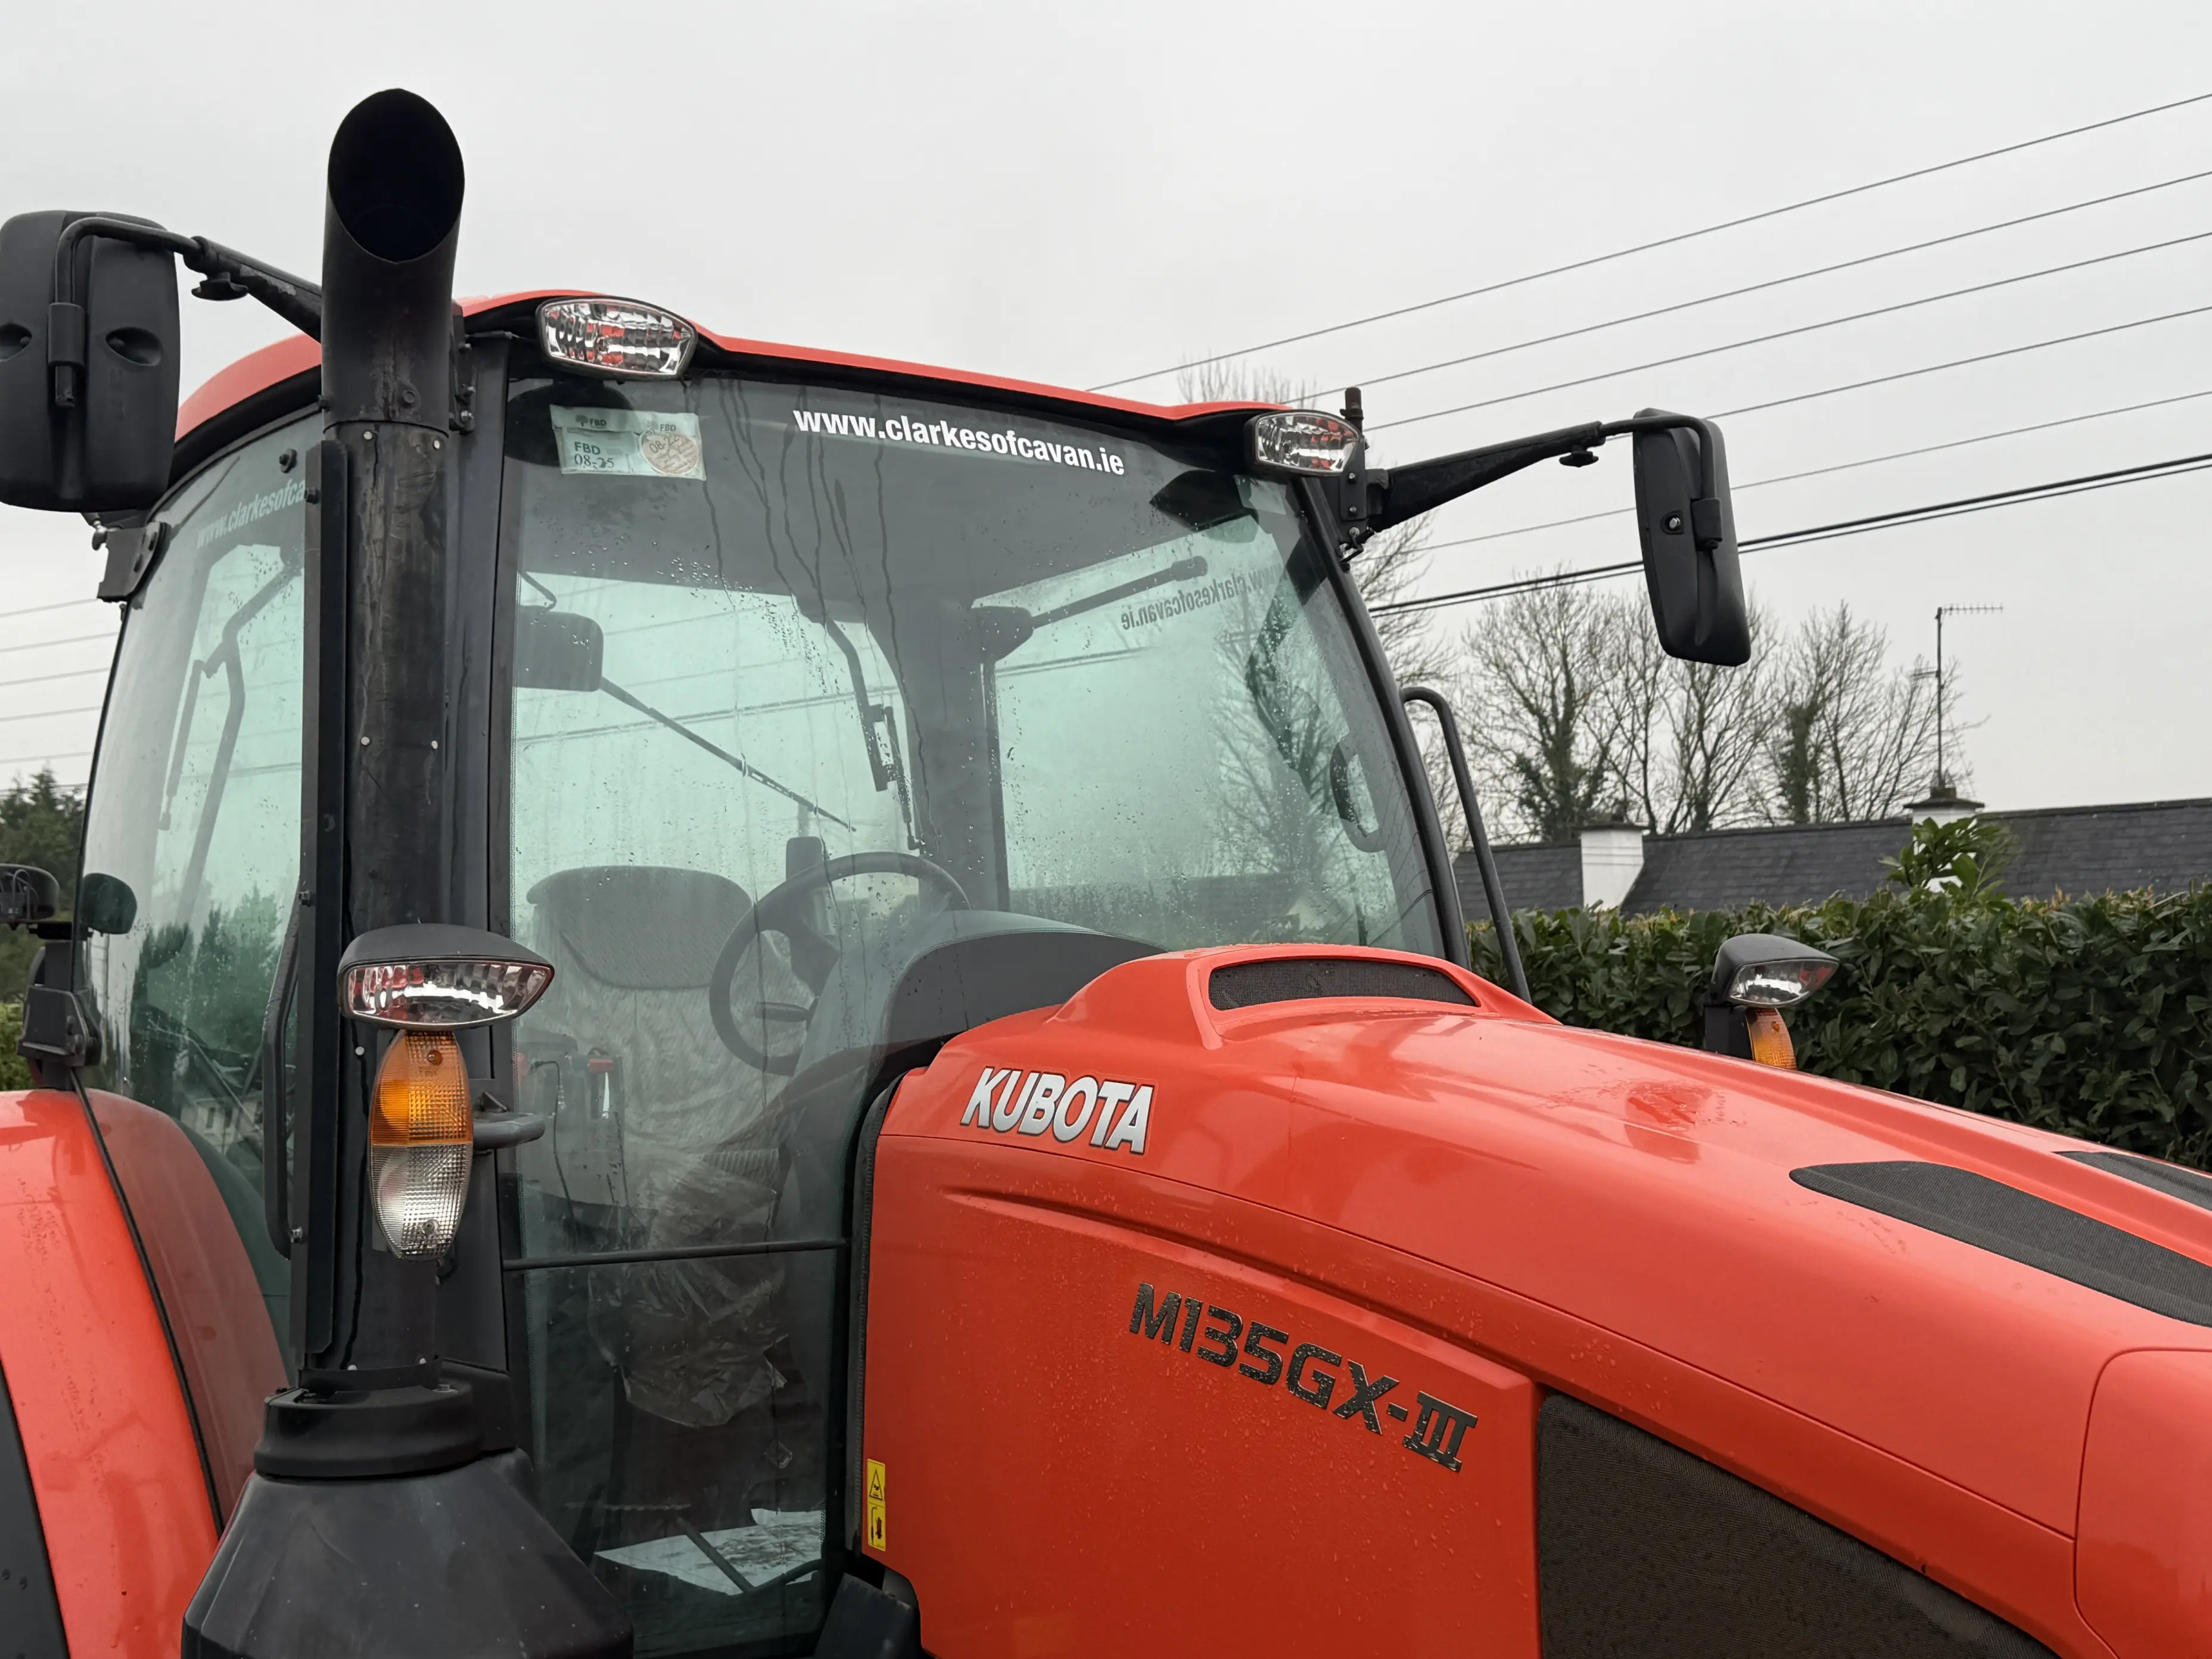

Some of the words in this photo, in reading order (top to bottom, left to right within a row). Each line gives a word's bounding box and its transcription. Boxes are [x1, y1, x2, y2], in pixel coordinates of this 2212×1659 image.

[574, 441, 601, 455] FBD
[590, 418, 606, 427] FBD
[793, 410, 1125, 475] www.clarkesofcavan.ie
[197, 478, 305, 549] www.clarkesofca
[960, 1066, 1154, 1155] KUBOTA
[1129, 1282, 1478, 1473] M135GX-III
